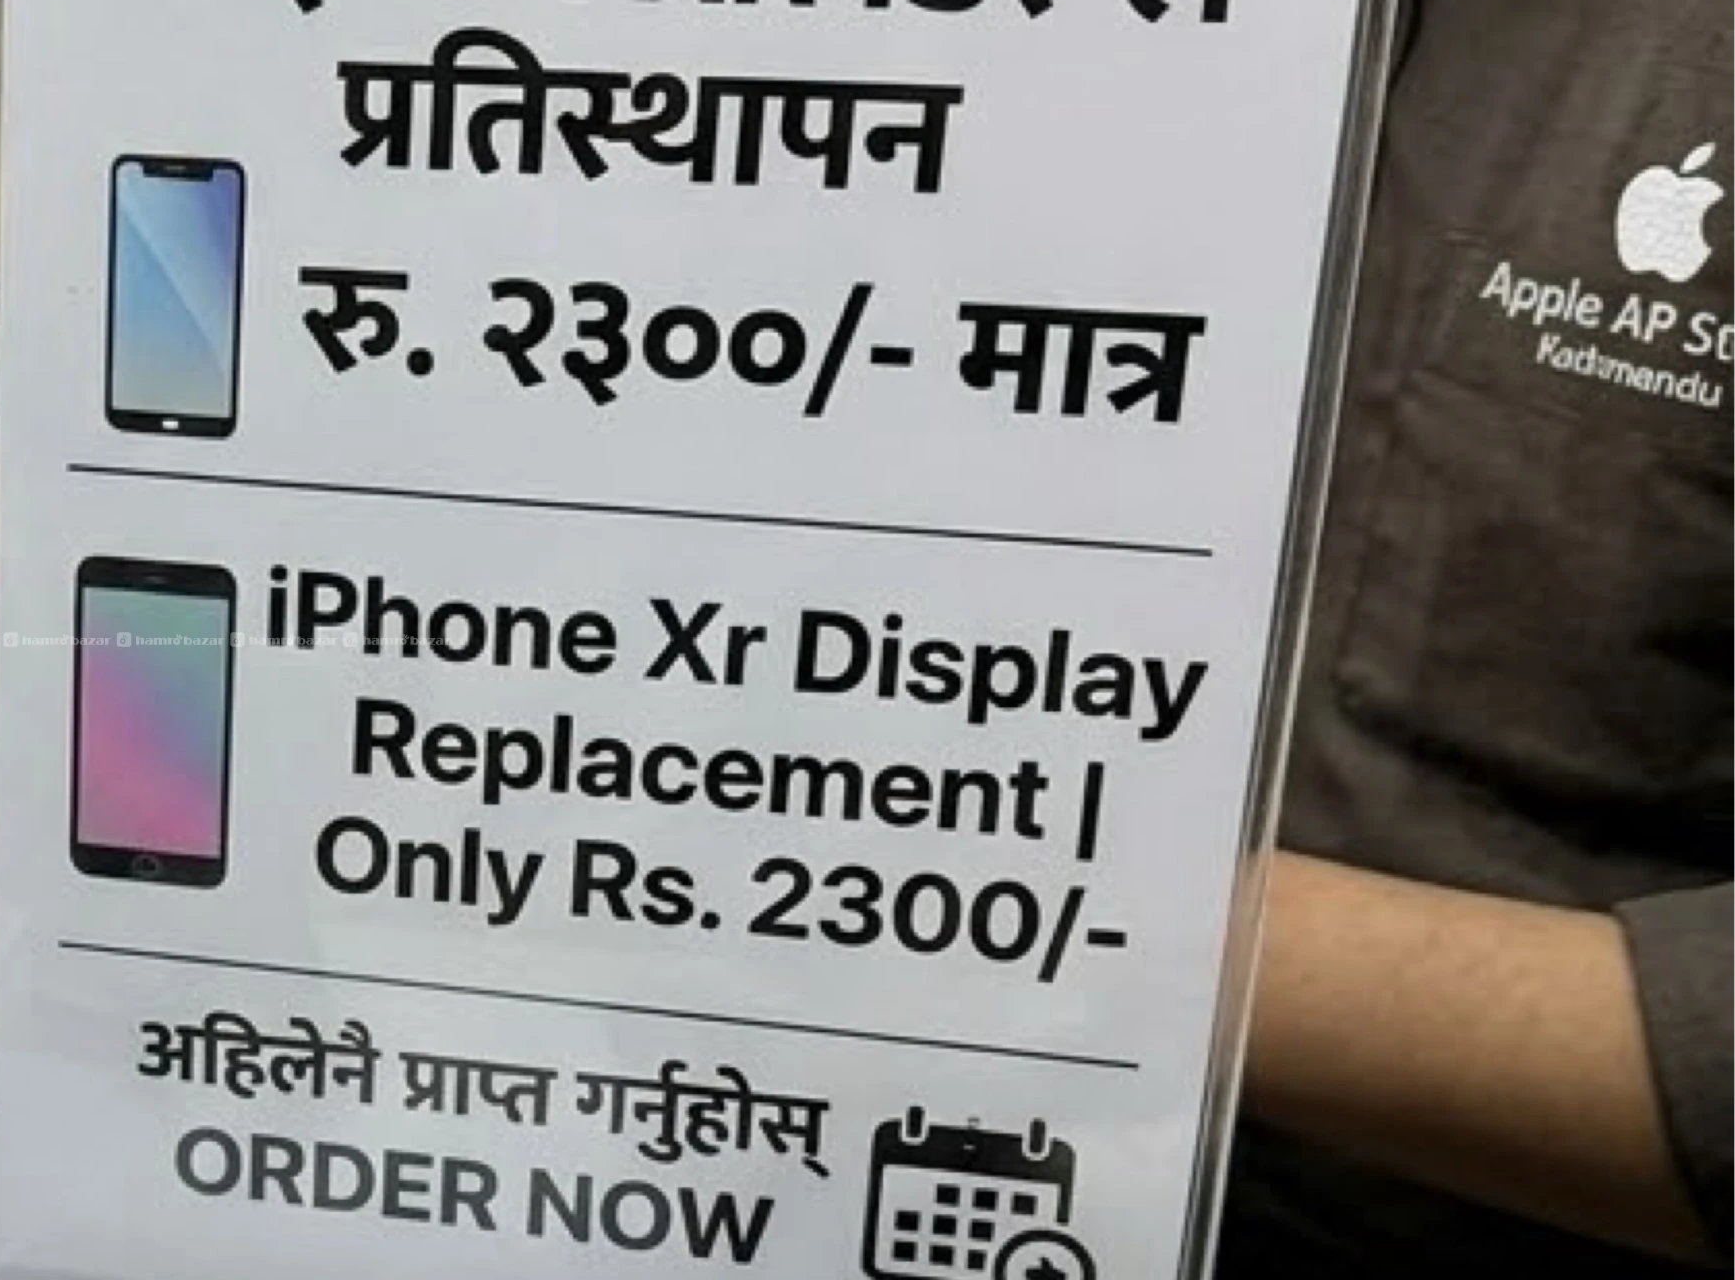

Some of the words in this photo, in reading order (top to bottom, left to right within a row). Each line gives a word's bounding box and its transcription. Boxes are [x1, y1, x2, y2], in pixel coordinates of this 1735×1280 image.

[336, 26, 965, 194] प्रतिस्थापन
[298, 266, 435, 377] रु.
[483, 277, 914, 418] २३००/-
[958, 301, 1208, 423] मात्र
[1479, 261, 1604, 328] Apple
[1609, 293, 1678, 344] AP
[267, 564, 617, 675] iPhone
[644, 598, 768, 686] Xr
[793, 609, 1209, 743] Display
[351, 697, 1047, 840] Replacement
[315, 815, 545, 927] Only
[571, 838, 721, 930] Rs.
[748, 856, 1127, 984] 2300/-
[137, 1010, 382, 1104] अहिलेनै
[398, 1052, 559, 1126] प्राप्त
[575, 1059, 831, 1178] गर्नुहोस्
[176, 1128, 497, 1231] ORDER
[527, 1168, 776, 1266] NOW
